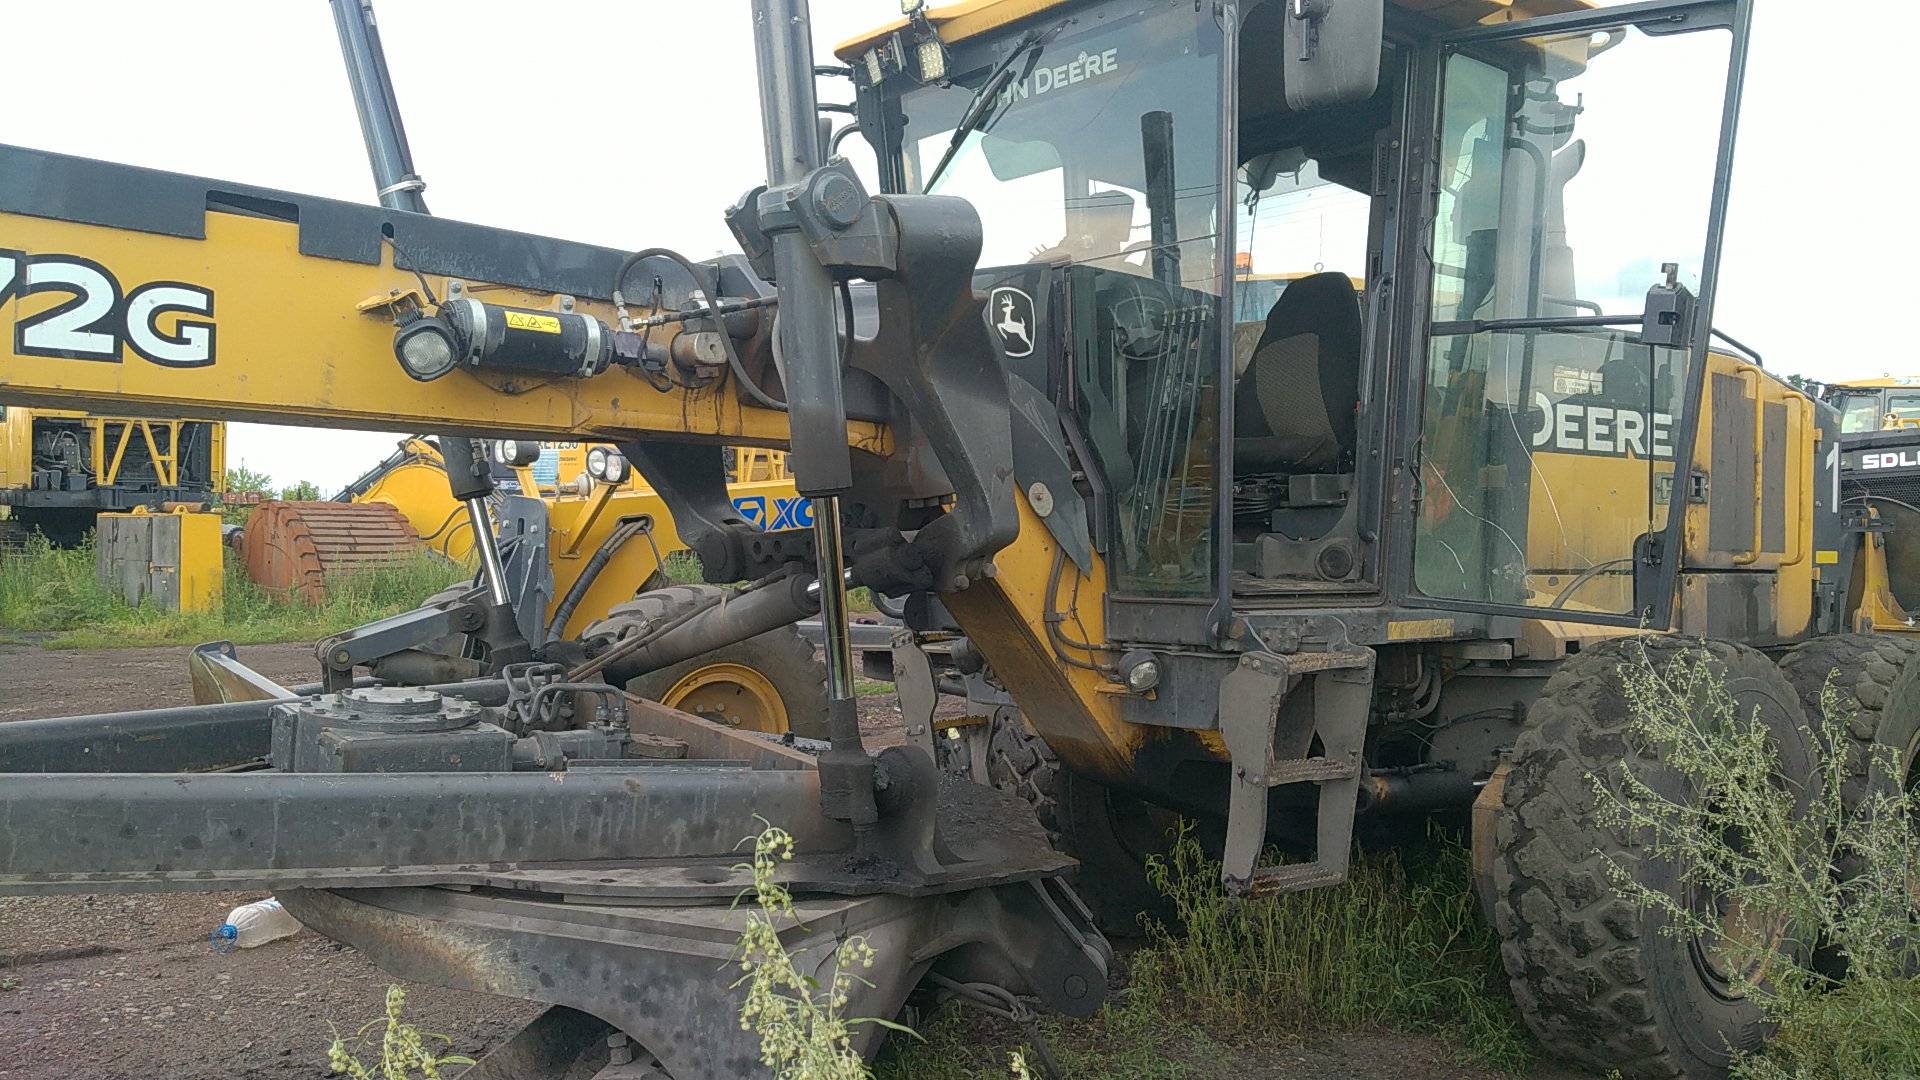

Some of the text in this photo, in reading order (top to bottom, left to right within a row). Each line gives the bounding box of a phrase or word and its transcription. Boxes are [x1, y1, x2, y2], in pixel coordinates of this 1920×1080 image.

[1035, 48, 1118, 95] DEERE
[0, 251, 216, 368] 2G
[1862, 450, 1920, 470] SDL
